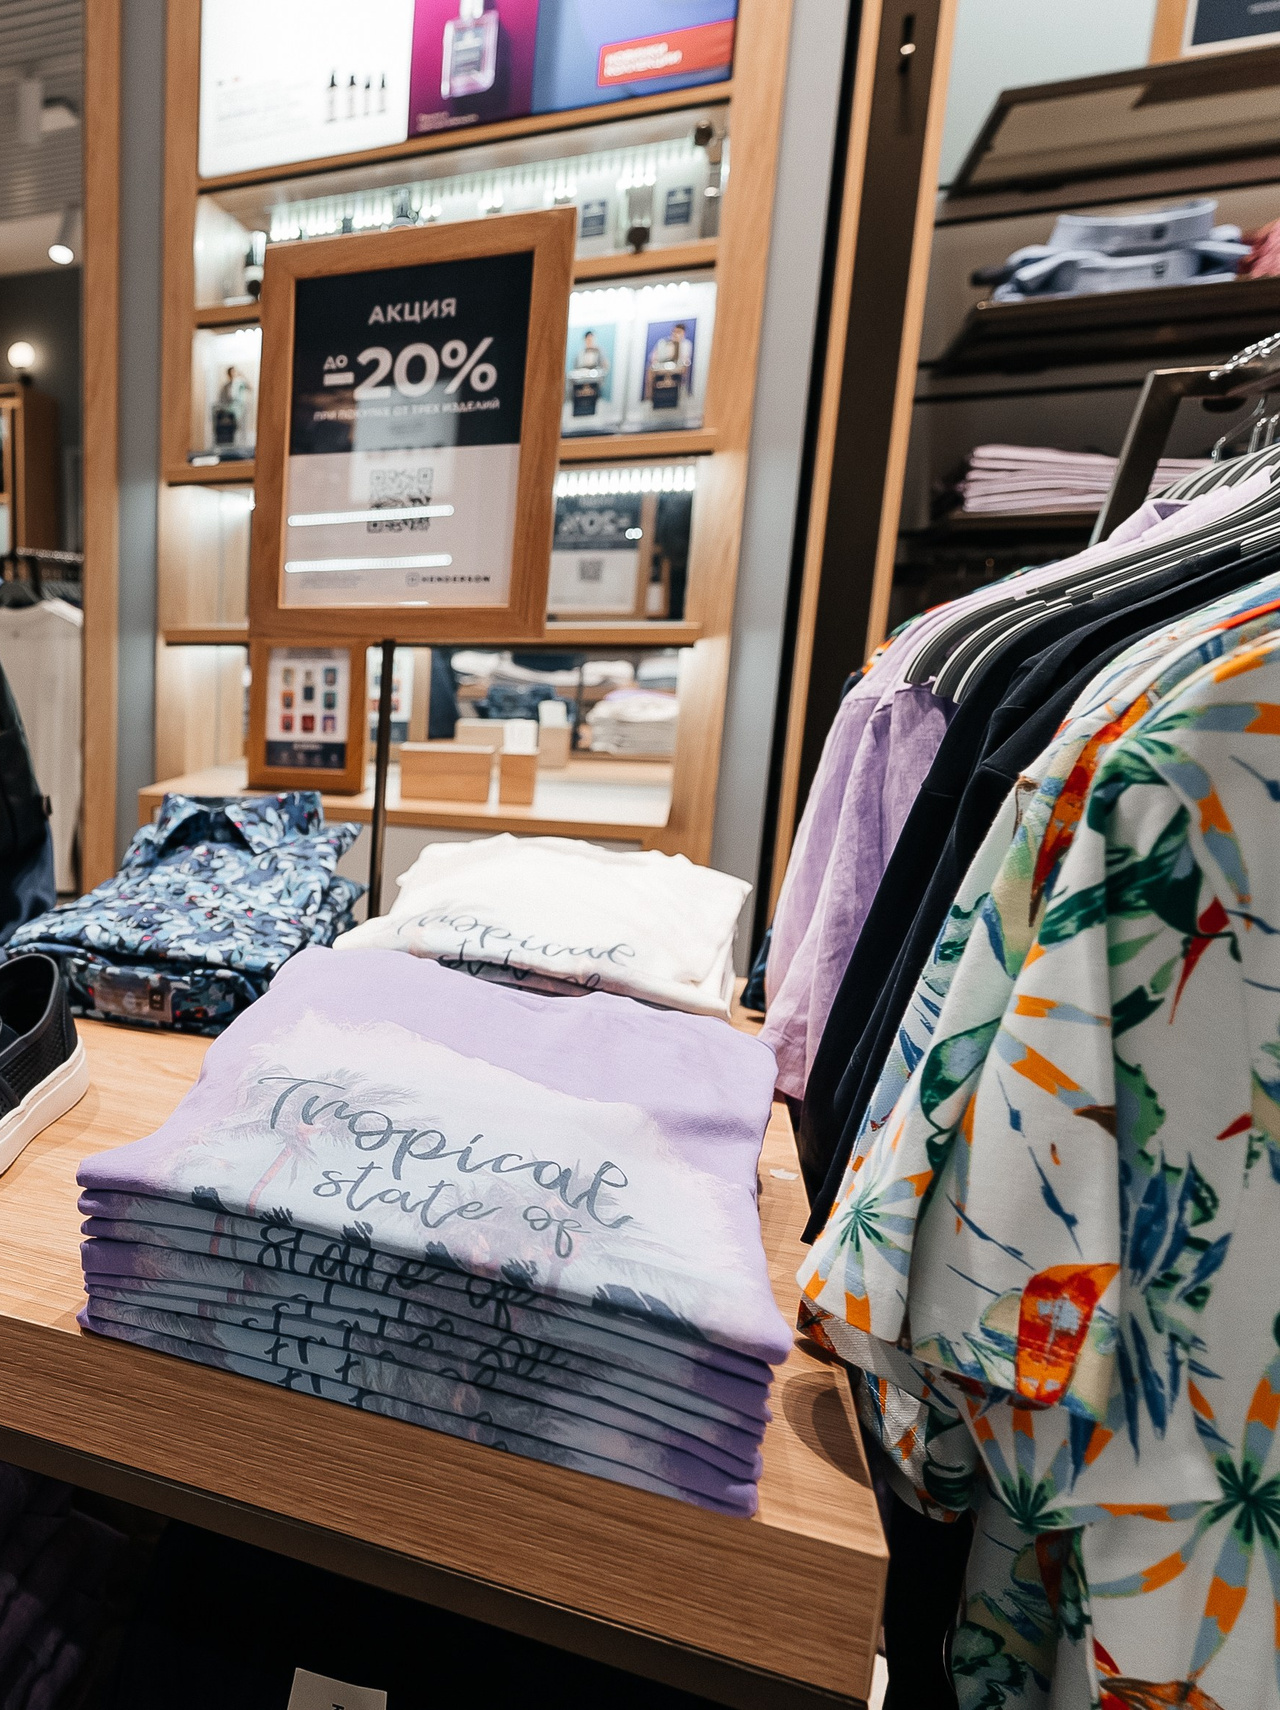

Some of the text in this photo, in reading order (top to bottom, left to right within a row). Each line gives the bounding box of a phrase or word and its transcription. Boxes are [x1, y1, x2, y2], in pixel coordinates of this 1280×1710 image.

[368, 297, 457, 325] АКЦИЯ
[323, 337, 497, 401] -20%
[258, 1076, 634, 1229] Tropical
[313, 1161, 591, 1259] state of
